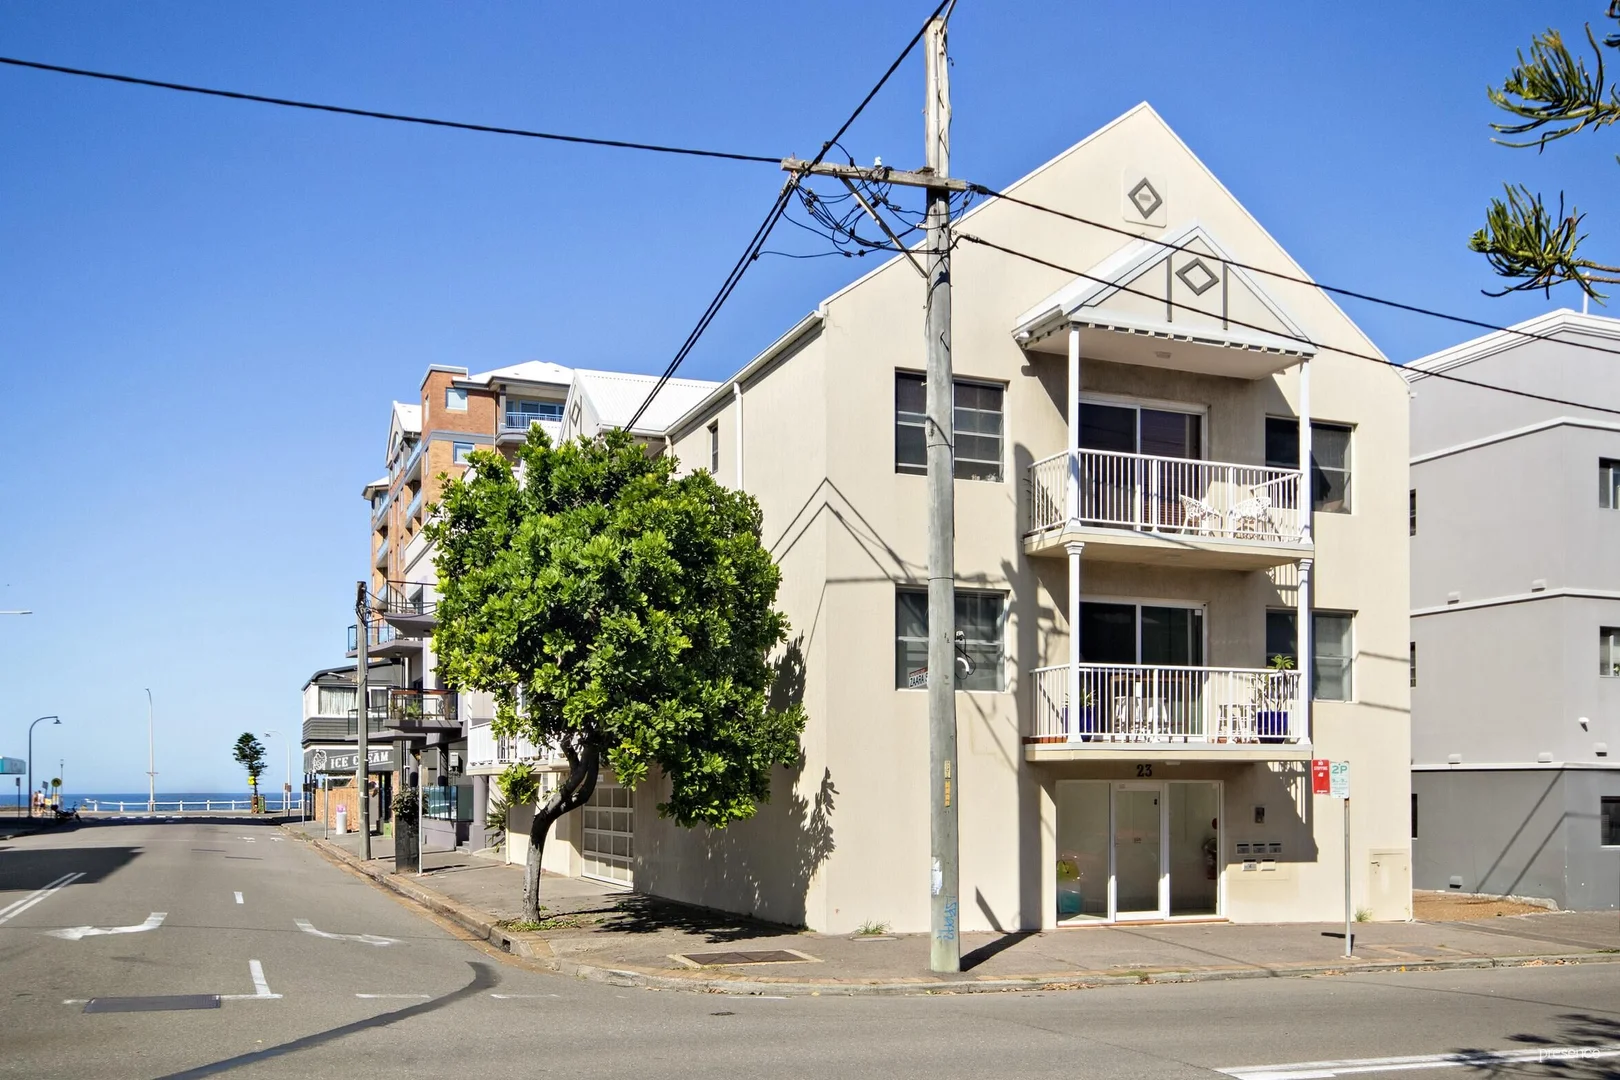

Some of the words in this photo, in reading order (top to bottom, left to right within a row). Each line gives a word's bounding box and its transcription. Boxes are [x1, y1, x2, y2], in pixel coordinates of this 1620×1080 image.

[331, 756, 349, 769] ICE
[352, 751, 389, 766] CEAM
[1136, 763, 1153, 778] 23
[1331, 765, 1348, 774] 2P
